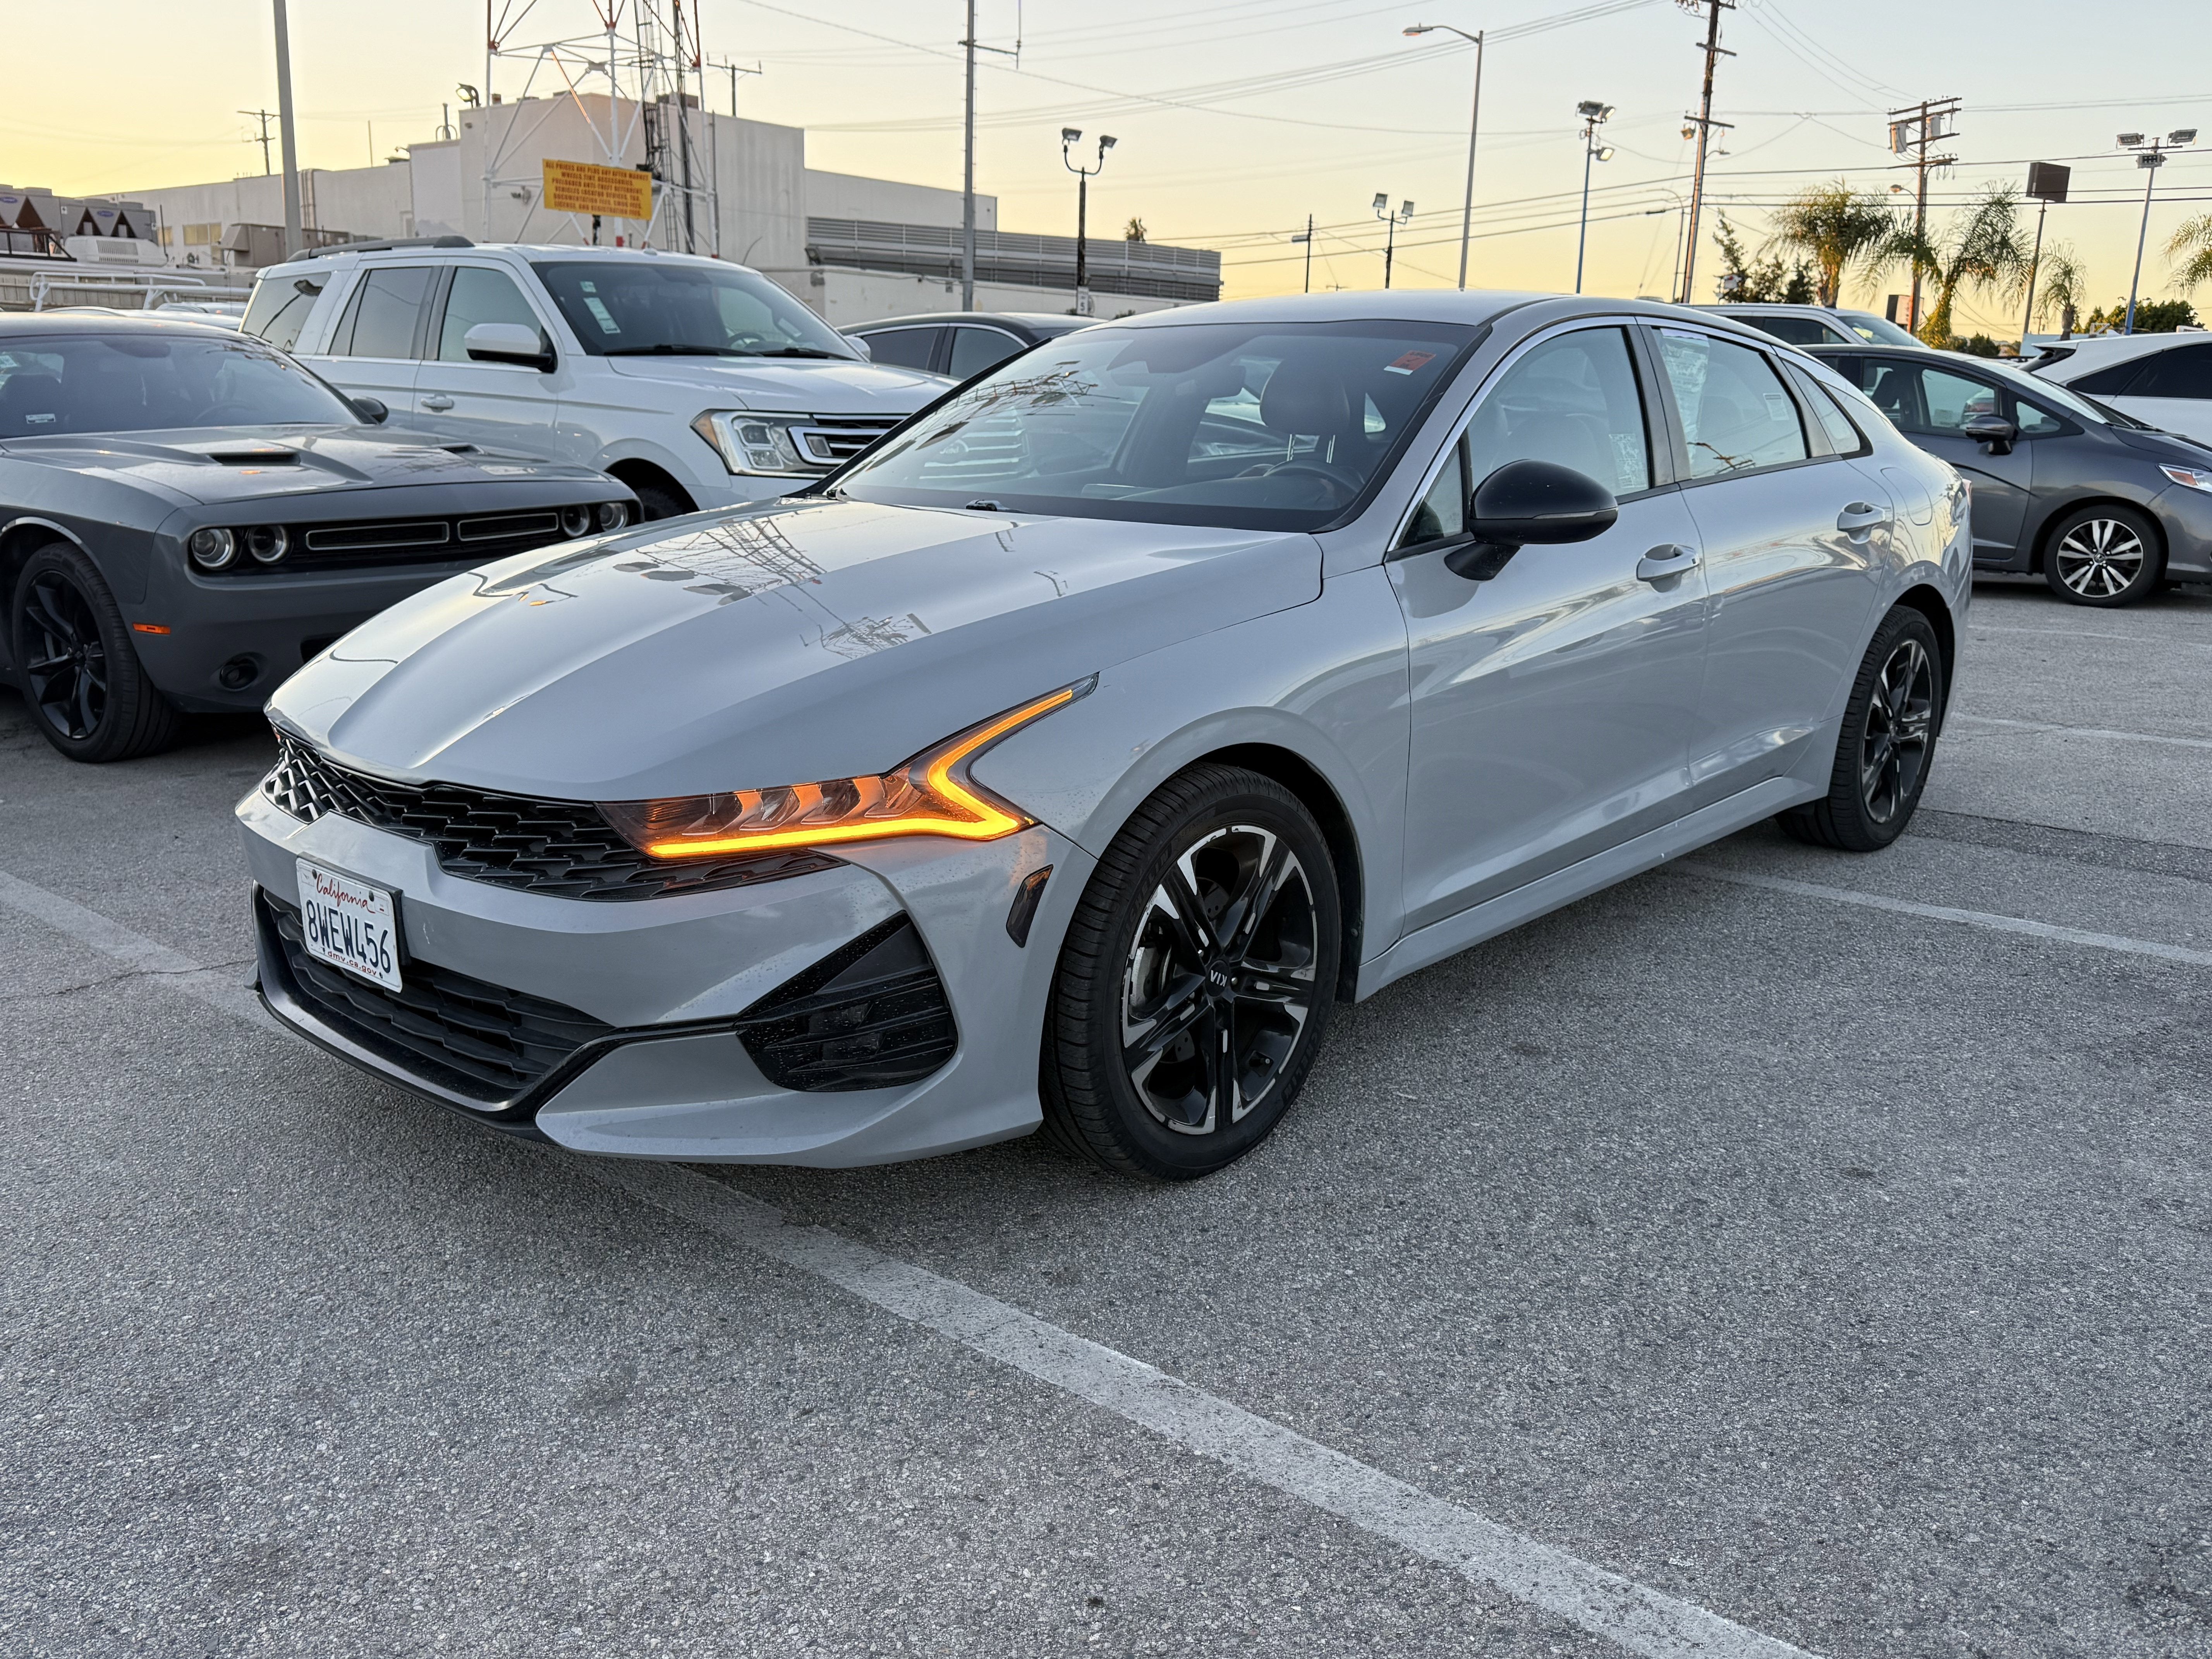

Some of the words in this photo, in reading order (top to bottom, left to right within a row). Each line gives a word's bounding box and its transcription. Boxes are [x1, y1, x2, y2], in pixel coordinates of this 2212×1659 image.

[1080, 302, 1085, 311] 5
[316, 873, 376, 914] California
[1121, 844, 1171, 943] MICHELIN
[306, 899, 391, 974] 8WEW456
[328, 951, 377, 976] dmv.ca.gov
[1211, 970, 1227, 987] KIA
